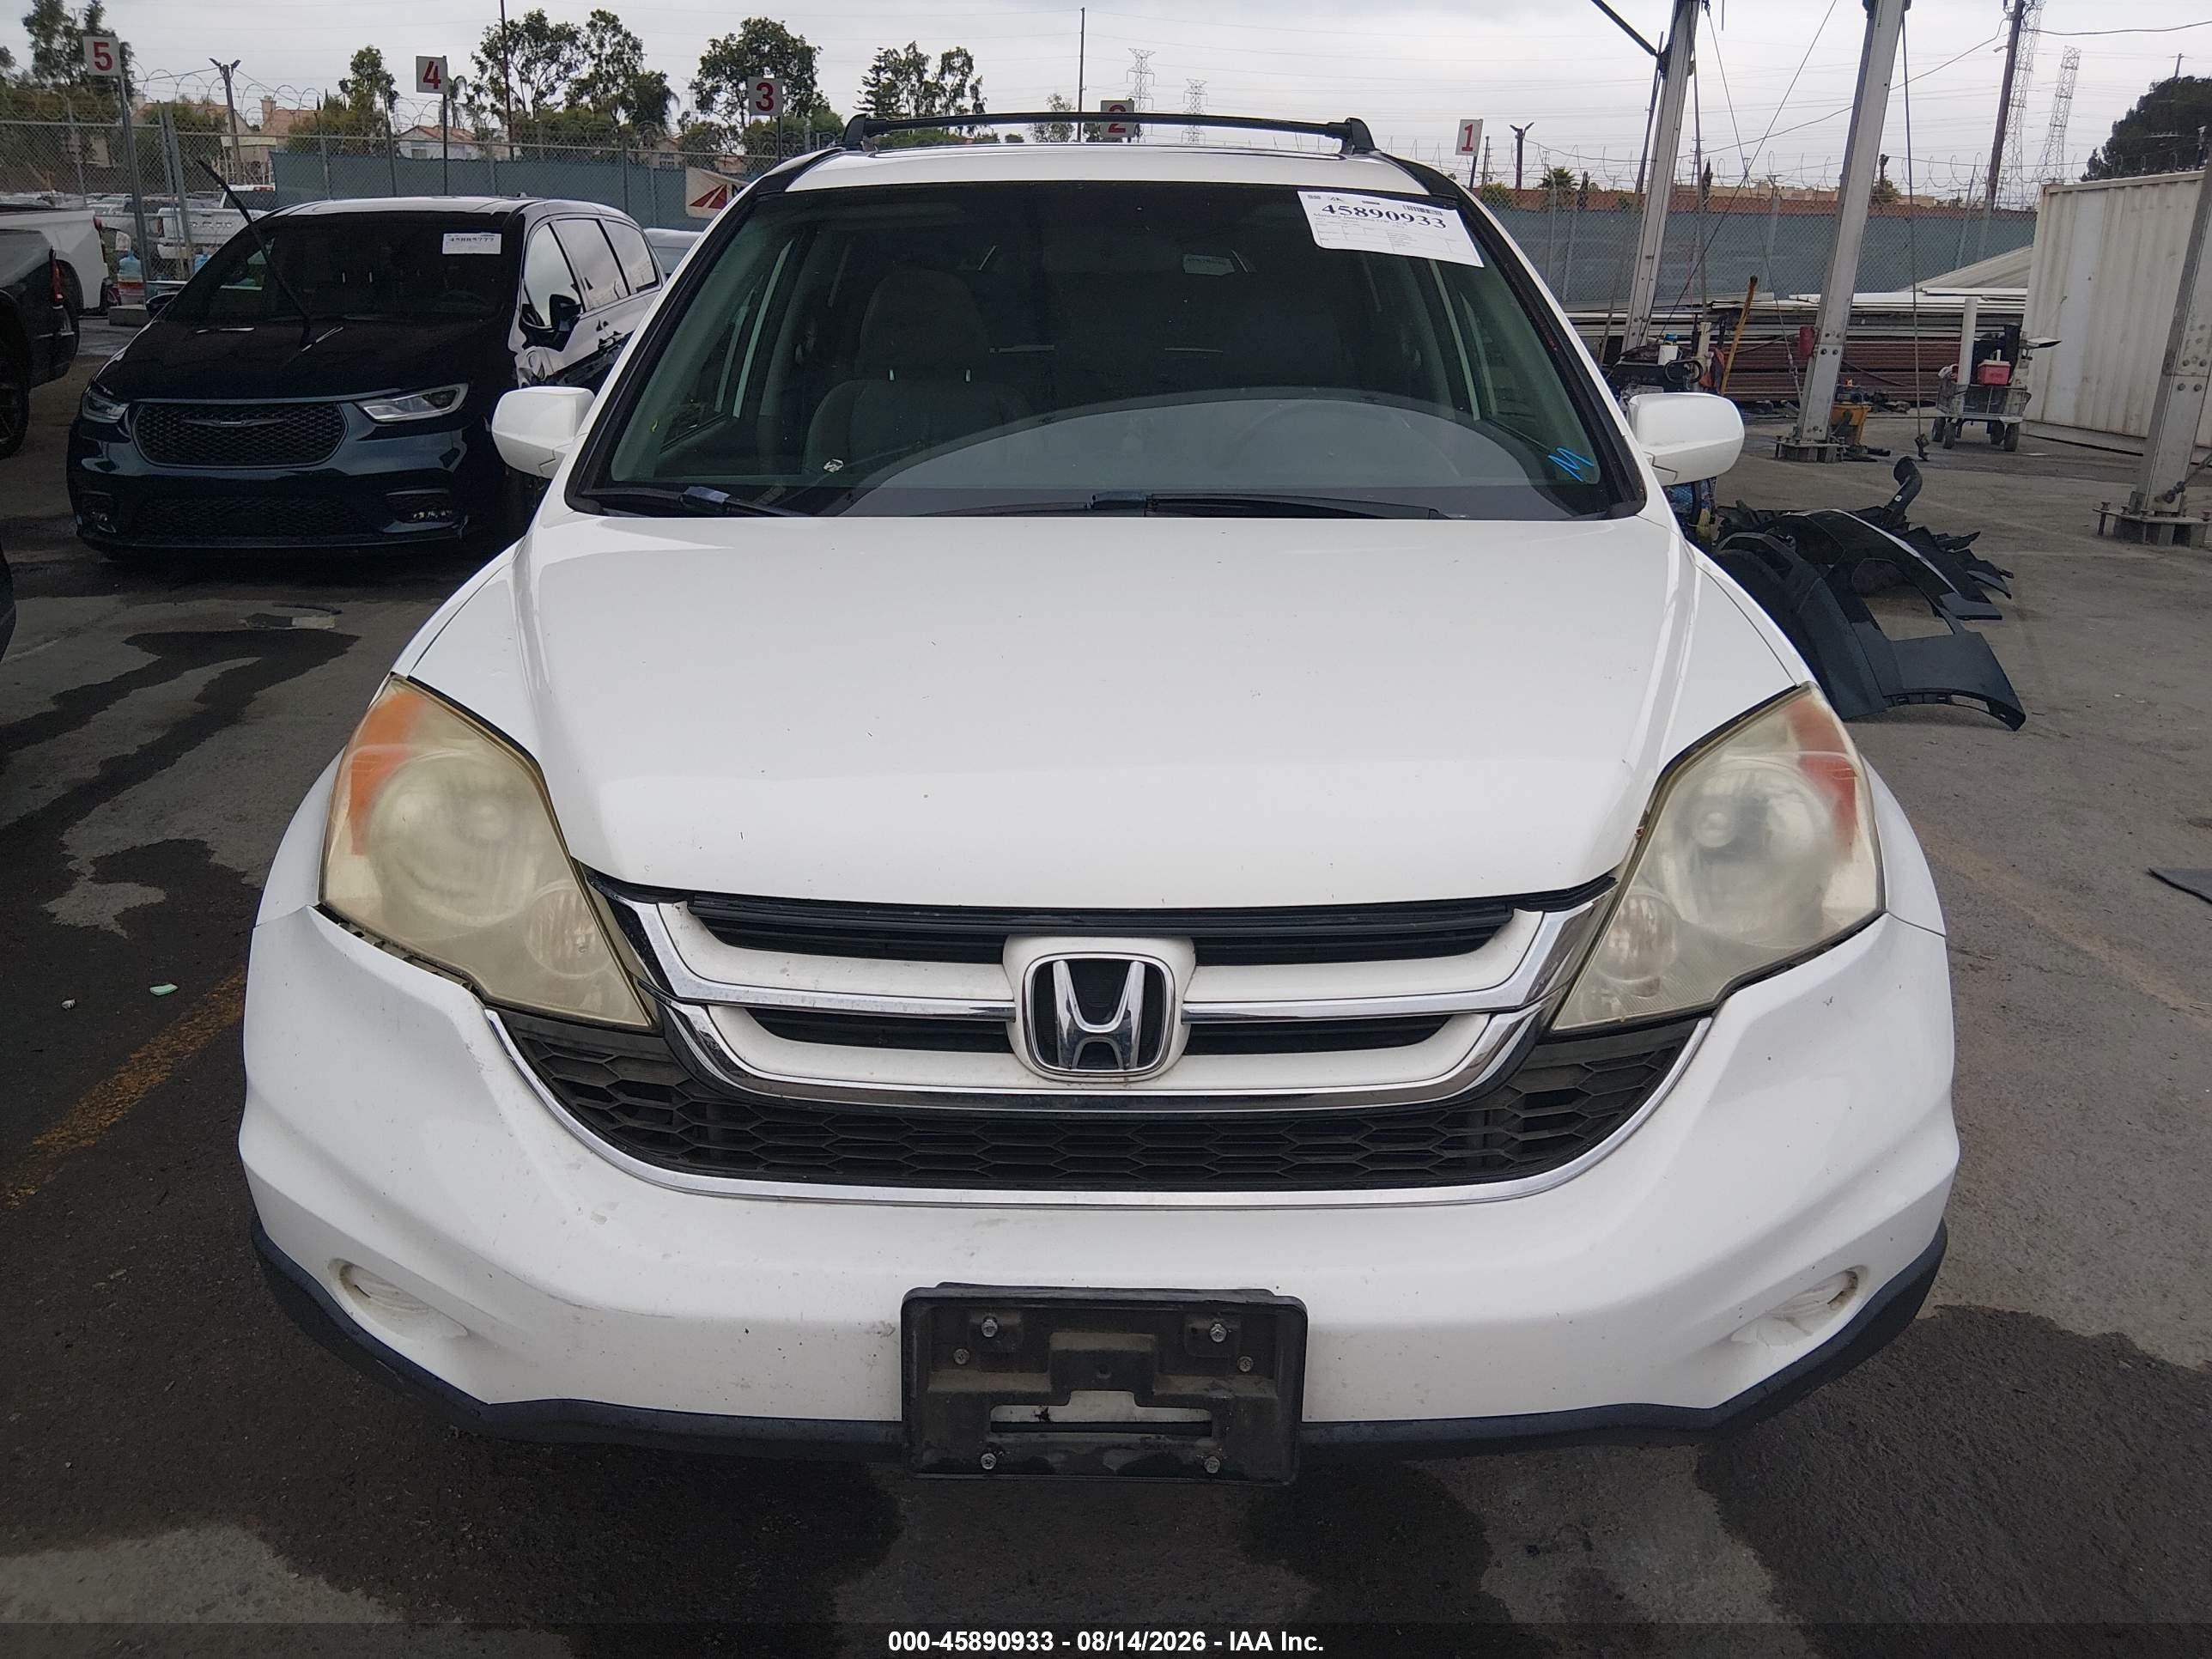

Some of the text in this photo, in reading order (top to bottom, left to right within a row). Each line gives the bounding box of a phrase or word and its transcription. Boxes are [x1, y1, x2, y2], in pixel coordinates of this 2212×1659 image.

[94, 41, 112, 71] 5
[422, 61, 441, 89] 4
[756, 82, 775, 112] 3
[1108, 104, 1127, 133] 2
[1462, 123, 1474, 152] 1
[1322, 204, 1447, 229] 45890933
